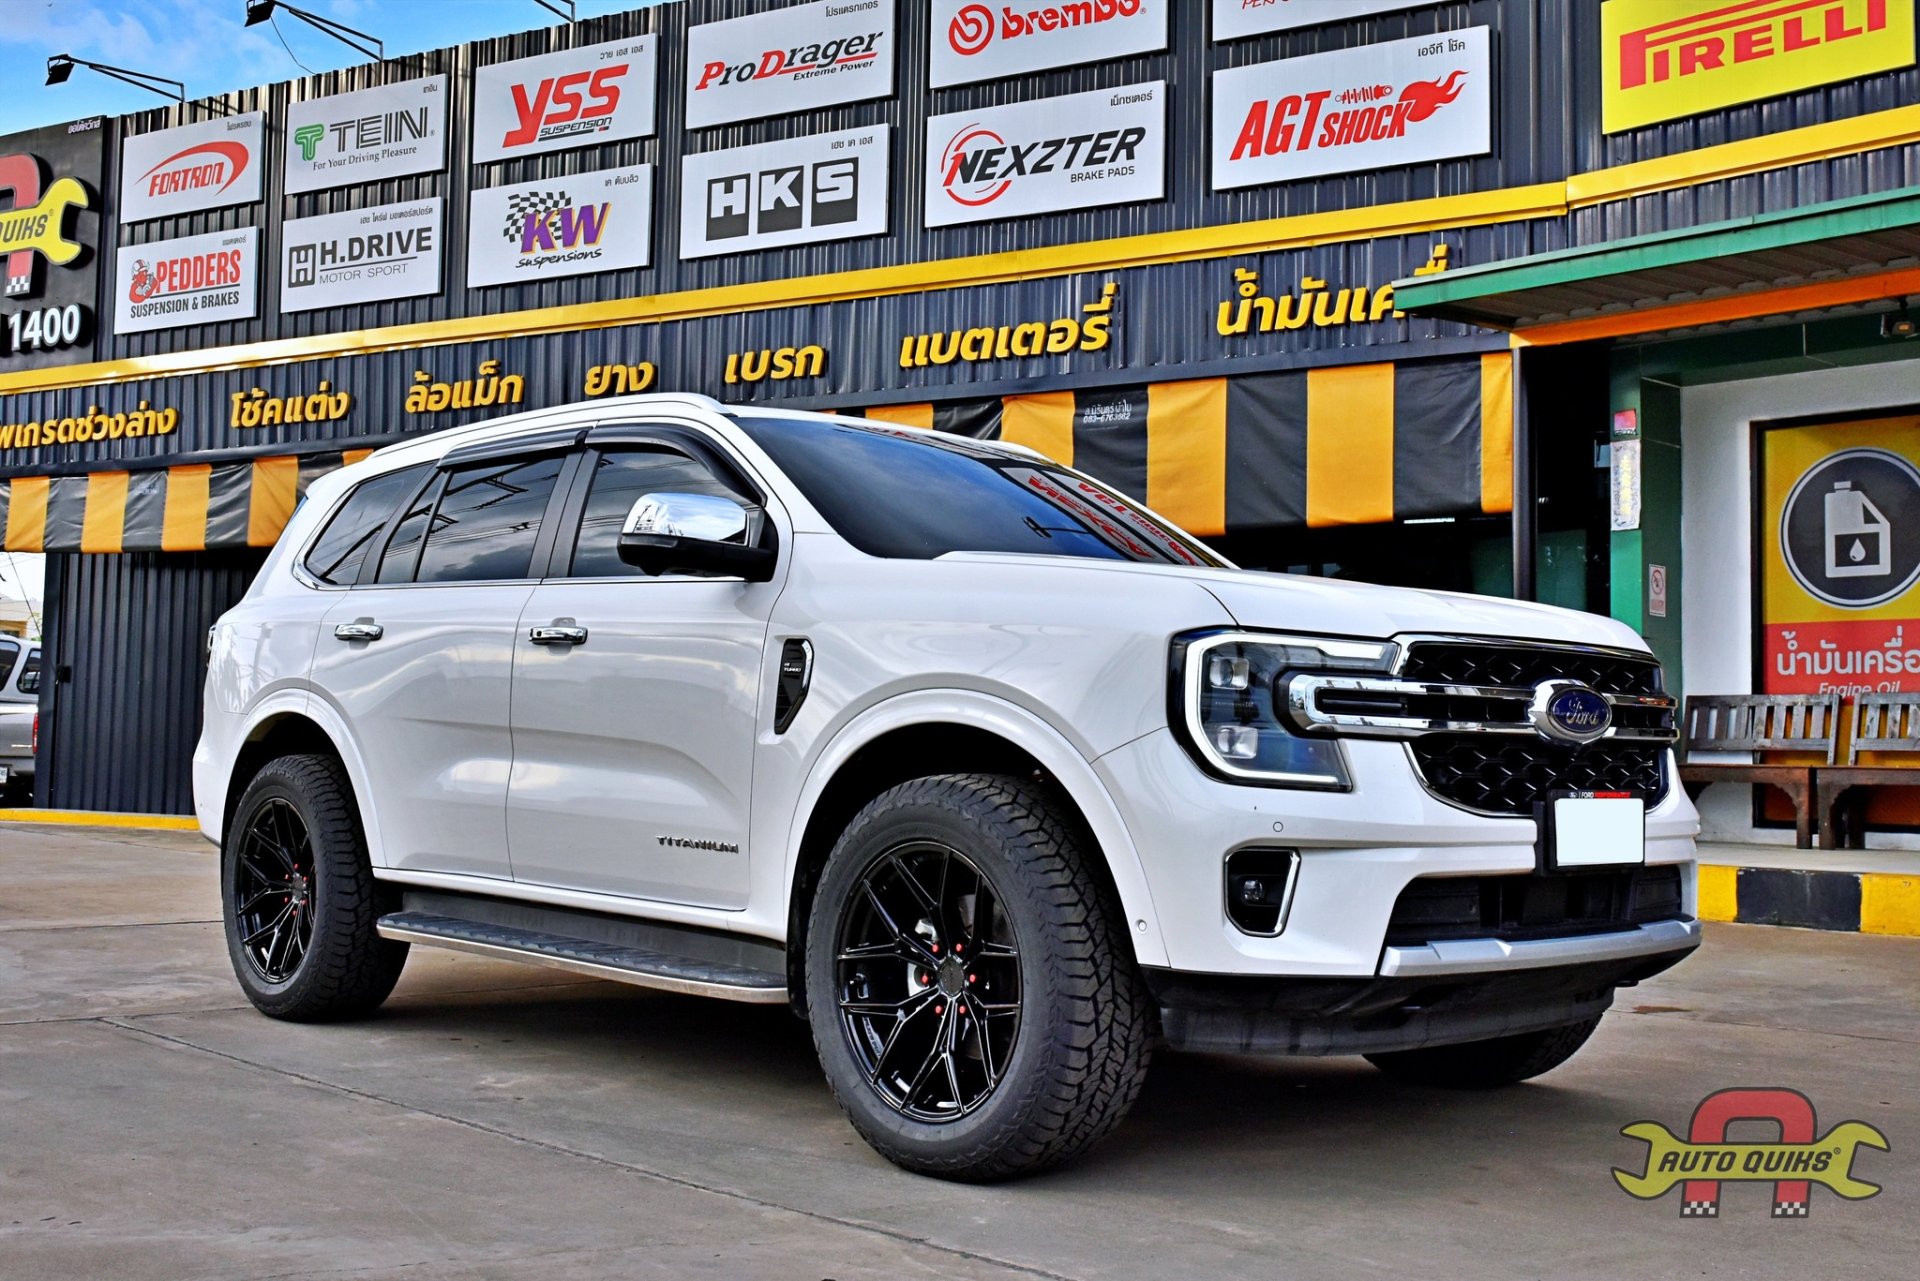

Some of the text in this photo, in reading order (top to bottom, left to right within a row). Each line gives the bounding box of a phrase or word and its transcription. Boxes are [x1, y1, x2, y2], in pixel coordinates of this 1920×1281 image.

[1001, 0, 1141, 39] brembo
[694, 31, 884, 90] ProDrager
[1620, 0, 1887, 91] PIRELLI
[793, 60, 874, 81] Extreme Power
[502, 63, 630, 148] YSS
[1229, 90, 1413, 161] AGT SHOCK
[329, 107, 428, 153] TEIN
[540, 117, 613, 137] SUSPENSION
[313, 146, 417, 171] For Your Driving Pleasure
[942, 126, 1147, 187] NEXZTER
[1070, 165, 1135, 183] BRAKE PADS
[148, 161, 225, 198] FORTRON
[709, 160, 855, 220] HKS
[319, 226, 433, 266] H.DRIVE
[520, 202, 612, 254] KW
[155, 249, 241, 294] PEDDERS
[319, 262, 409, 285] MOTOR SPORT
[515, 248, 603, 270] suspensions
[130, 290, 240, 319] SUSPENSION & BRAKES
[899, 282, 1119, 368] แบตเตอรี่
[8, 303, 81, 351] 1400
[583, 361, 656, 396] ยาง
[723, 344, 827, 385] เบรก
[230, 380, 350, 429] โช้คแต่ง
[404, 359, 525, 414] ล้อแม็ก
[0, 400, 179, 450] พเกรดช่วงล่าง
[1819, 680, 1901, 700] Engine Oil
[1566, 697, 1600, 726] Ford
[656, 836, 739, 854] TITANIUM
